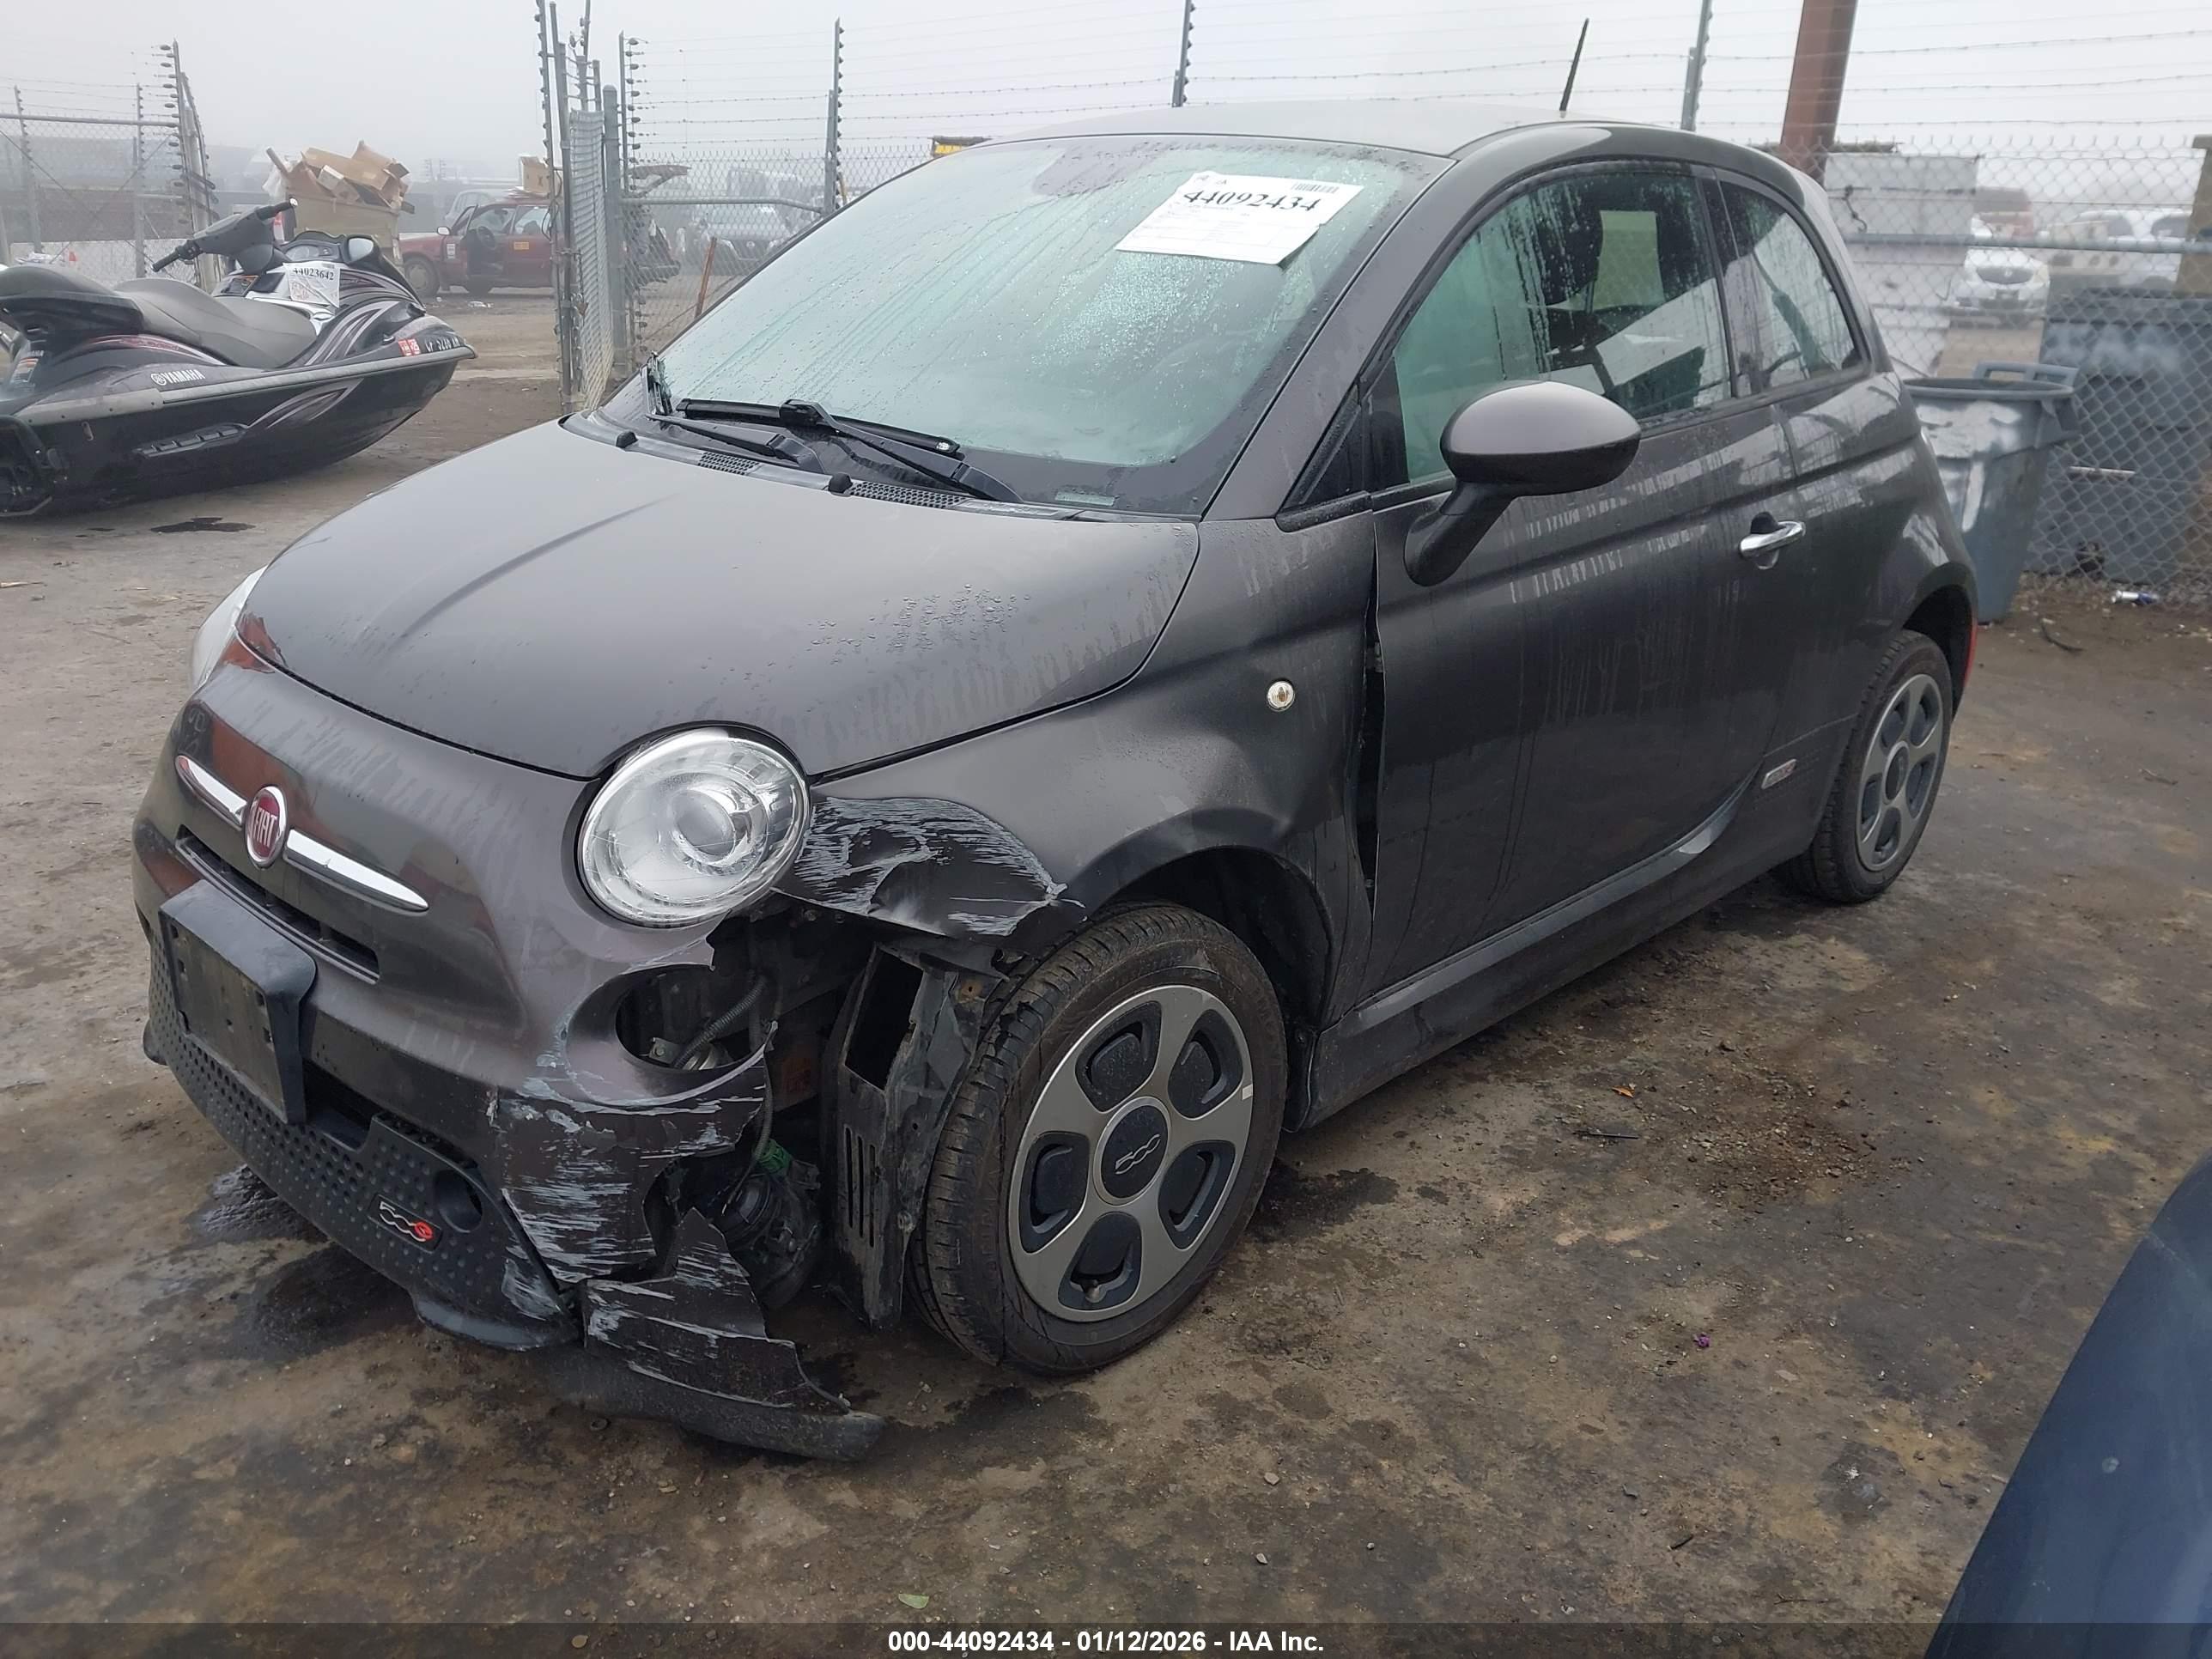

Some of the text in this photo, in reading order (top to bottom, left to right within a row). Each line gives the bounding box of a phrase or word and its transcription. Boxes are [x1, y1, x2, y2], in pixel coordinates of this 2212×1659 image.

[1183, 190, 1321, 211] 44092434
[160, 369, 206, 384] YAMAHA
[248, 803, 278, 848] FIAT
